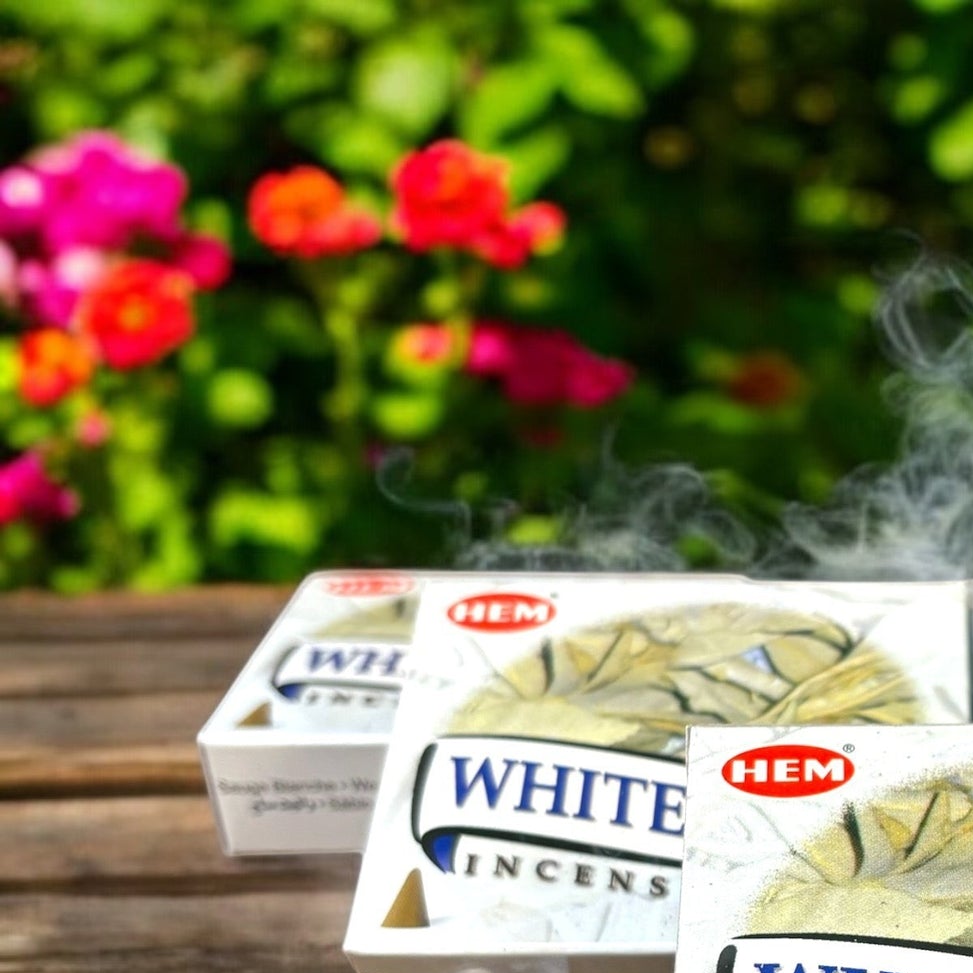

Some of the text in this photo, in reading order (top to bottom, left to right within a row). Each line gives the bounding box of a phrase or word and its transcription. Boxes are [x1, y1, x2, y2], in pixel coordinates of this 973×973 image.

[454, 602, 549, 624] HEM
[308, 646, 404, 678] WH
[731, 758, 846, 784] HEM
[450, 756, 687, 837] WHITE
[464, 853, 670, 899] INCENS
